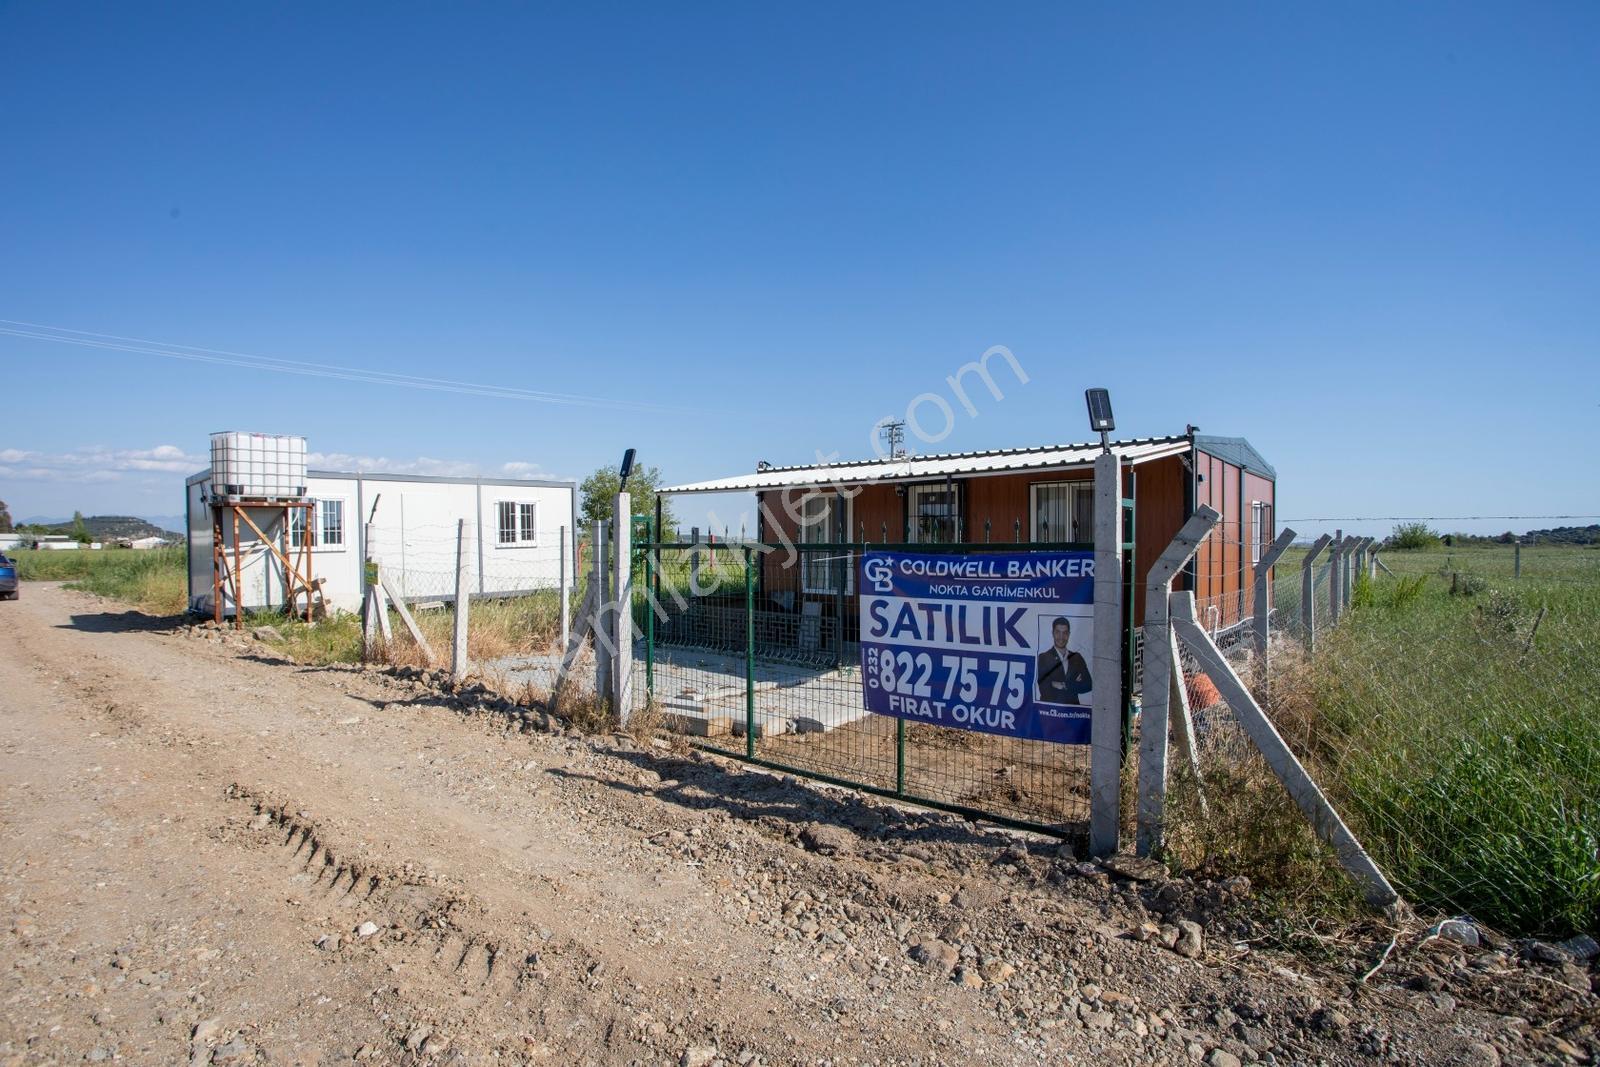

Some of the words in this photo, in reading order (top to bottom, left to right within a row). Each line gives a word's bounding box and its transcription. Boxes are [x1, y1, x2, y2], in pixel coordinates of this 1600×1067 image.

[900, 559, 1002, 578] COLDWELL
[1007, 559, 1095, 578] BANKER
[929, 585, 968, 596] NOKTA
[971, 584, 1060, 599] GAYRİMENKUL
[869, 599, 1031, 649] SATILIK
[868, 647, 879, 675] 232
[880, 650, 933, 698] 822
[942, 656, 978, 703] 75
[988, 659, 1026, 710] 75
[889, 695, 946, 720] FIRAT
[952, 705, 1016, 730] OKUR
